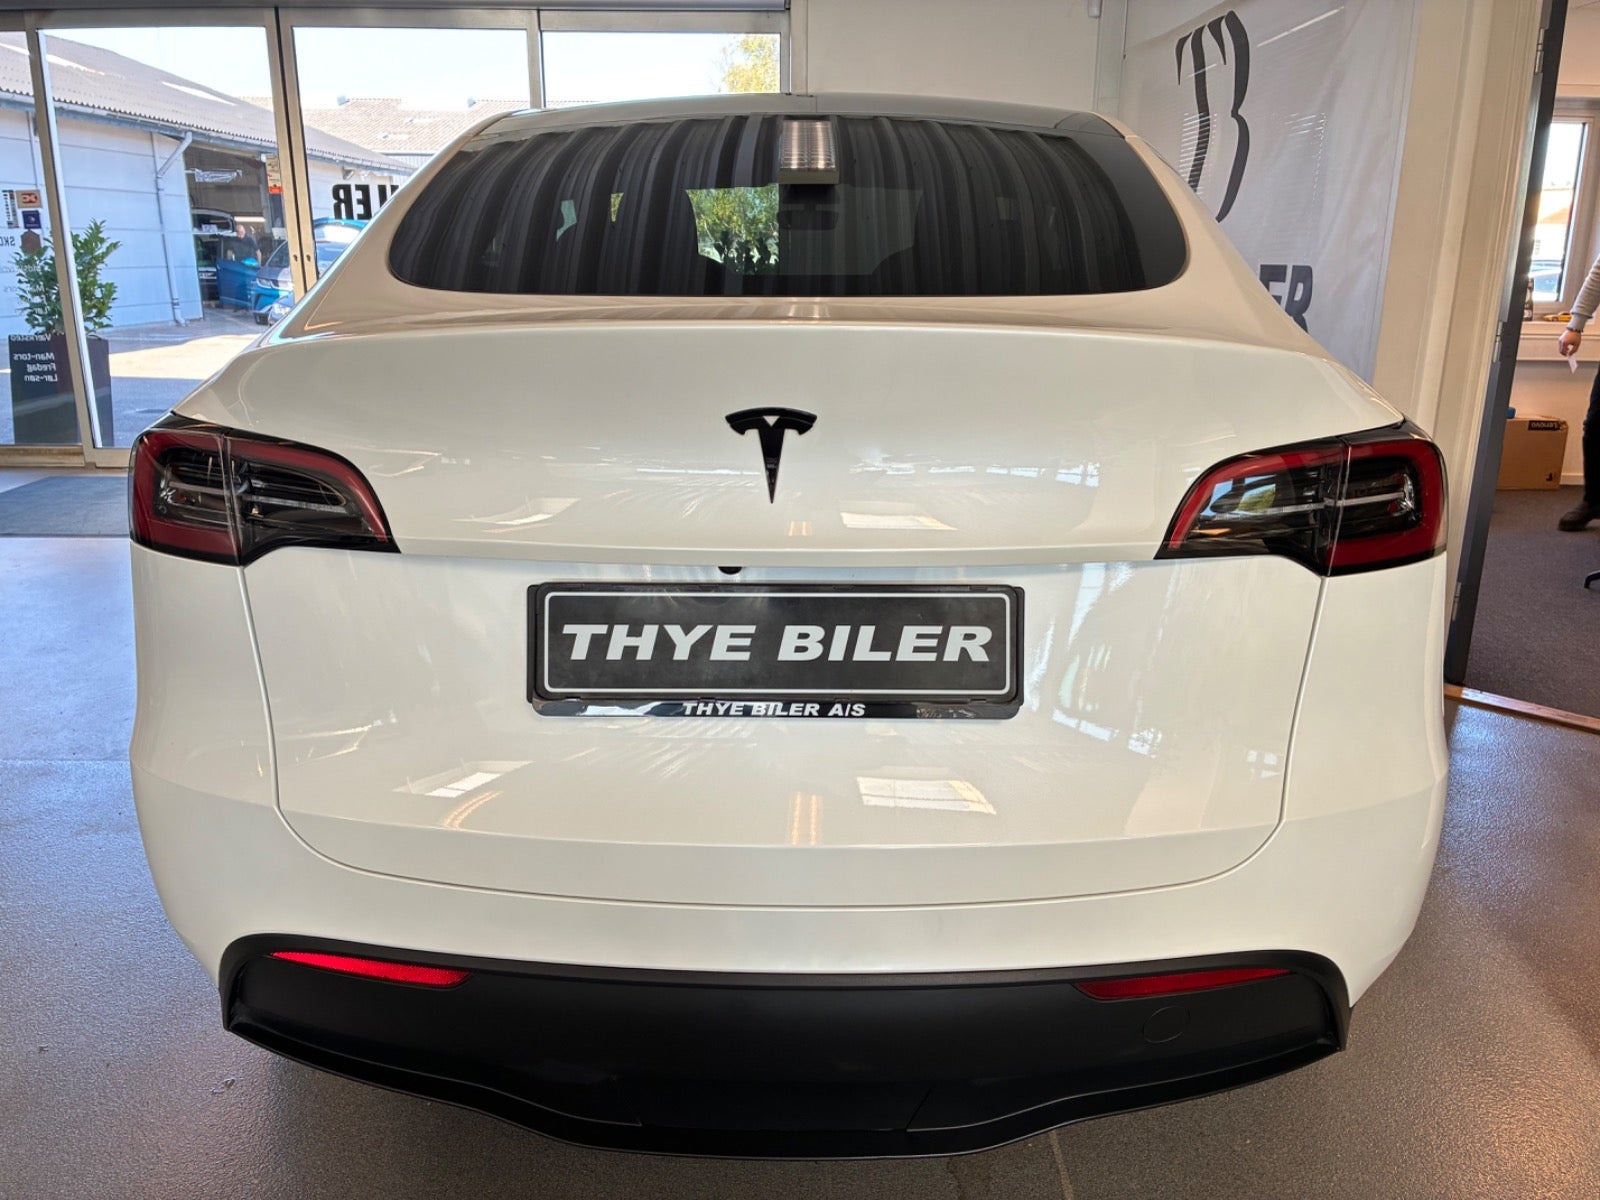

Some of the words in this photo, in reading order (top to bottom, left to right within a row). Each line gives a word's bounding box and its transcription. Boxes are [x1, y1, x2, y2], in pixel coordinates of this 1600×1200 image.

[562, 624, 756, 661] THYE
[777, 625, 993, 662] BILER
[683, 702, 745, 715] THYE
[751, 702, 820, 716] BILER
[828, 703, 866, 716] A/S
